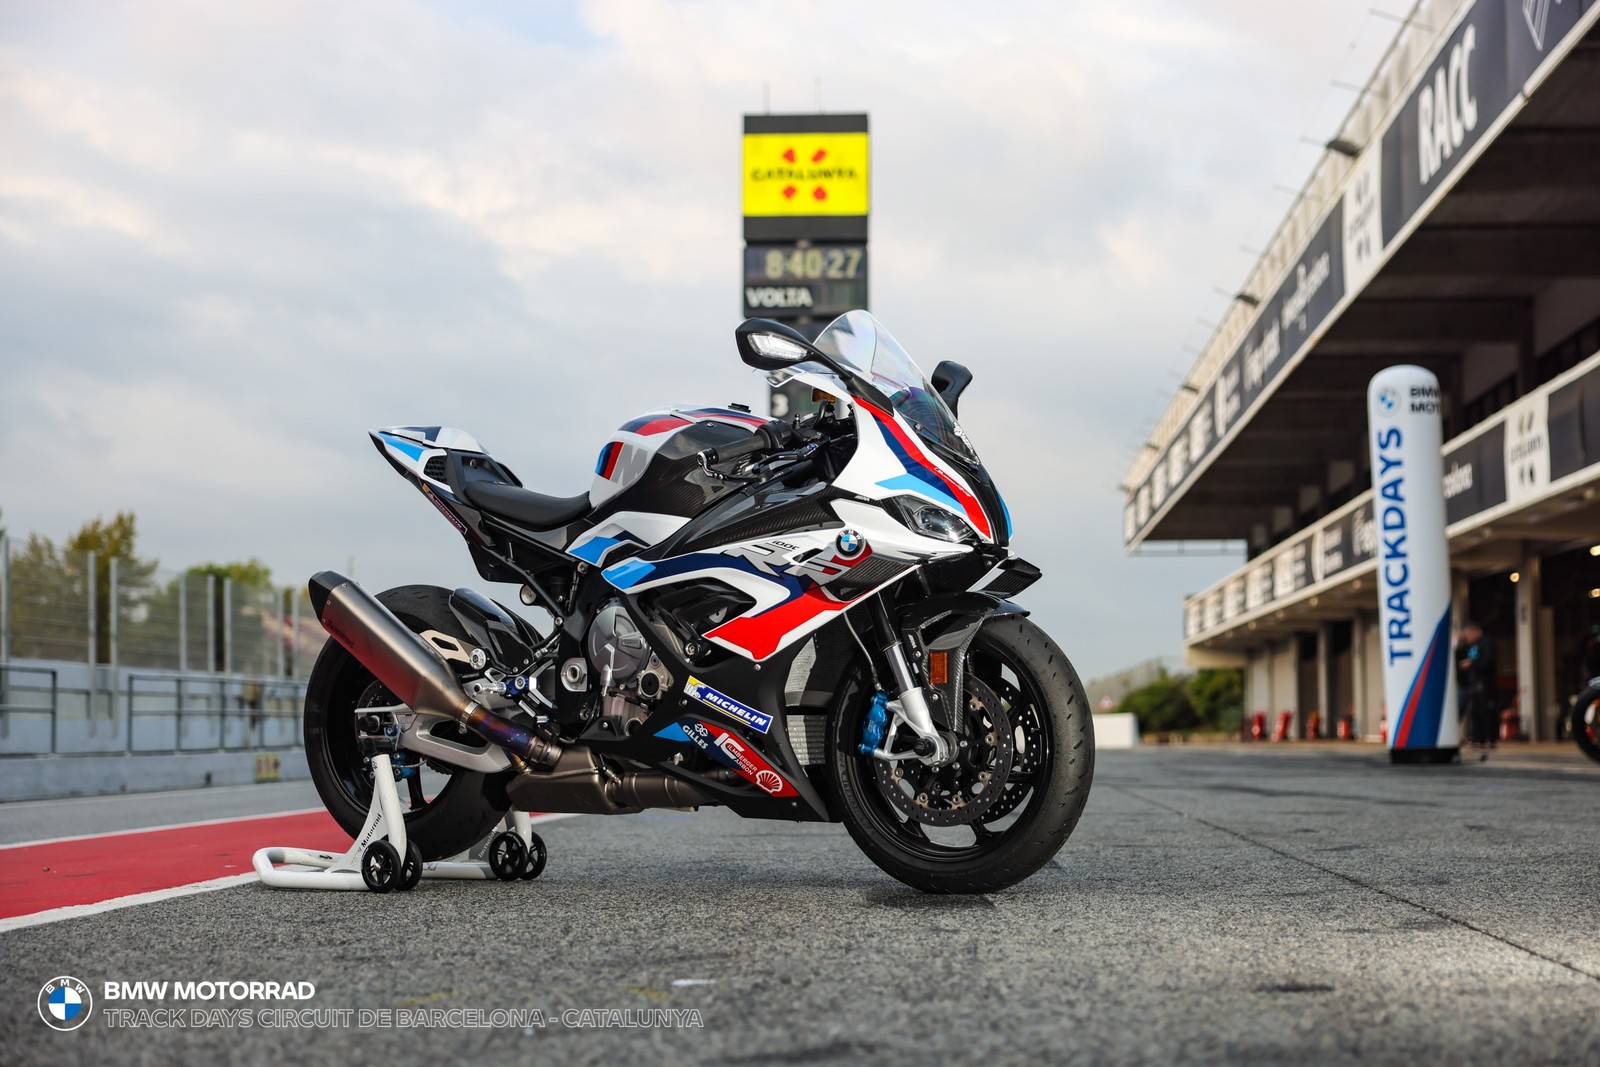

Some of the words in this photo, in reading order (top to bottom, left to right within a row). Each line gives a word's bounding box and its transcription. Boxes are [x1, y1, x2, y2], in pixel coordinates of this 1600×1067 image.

[1418, 24, 1478, 185] RACC
[745, 286, 813, 308] VOLTA
[1378, 428, 1413, 666] TRACKDAYS
[705, 692, 767, 727] MICHELIN
[682, 725, 708, 749] GILLES
[727, 744, 758, 772] ILMBERGER
[361, 813, 382, 847] Motorrad
